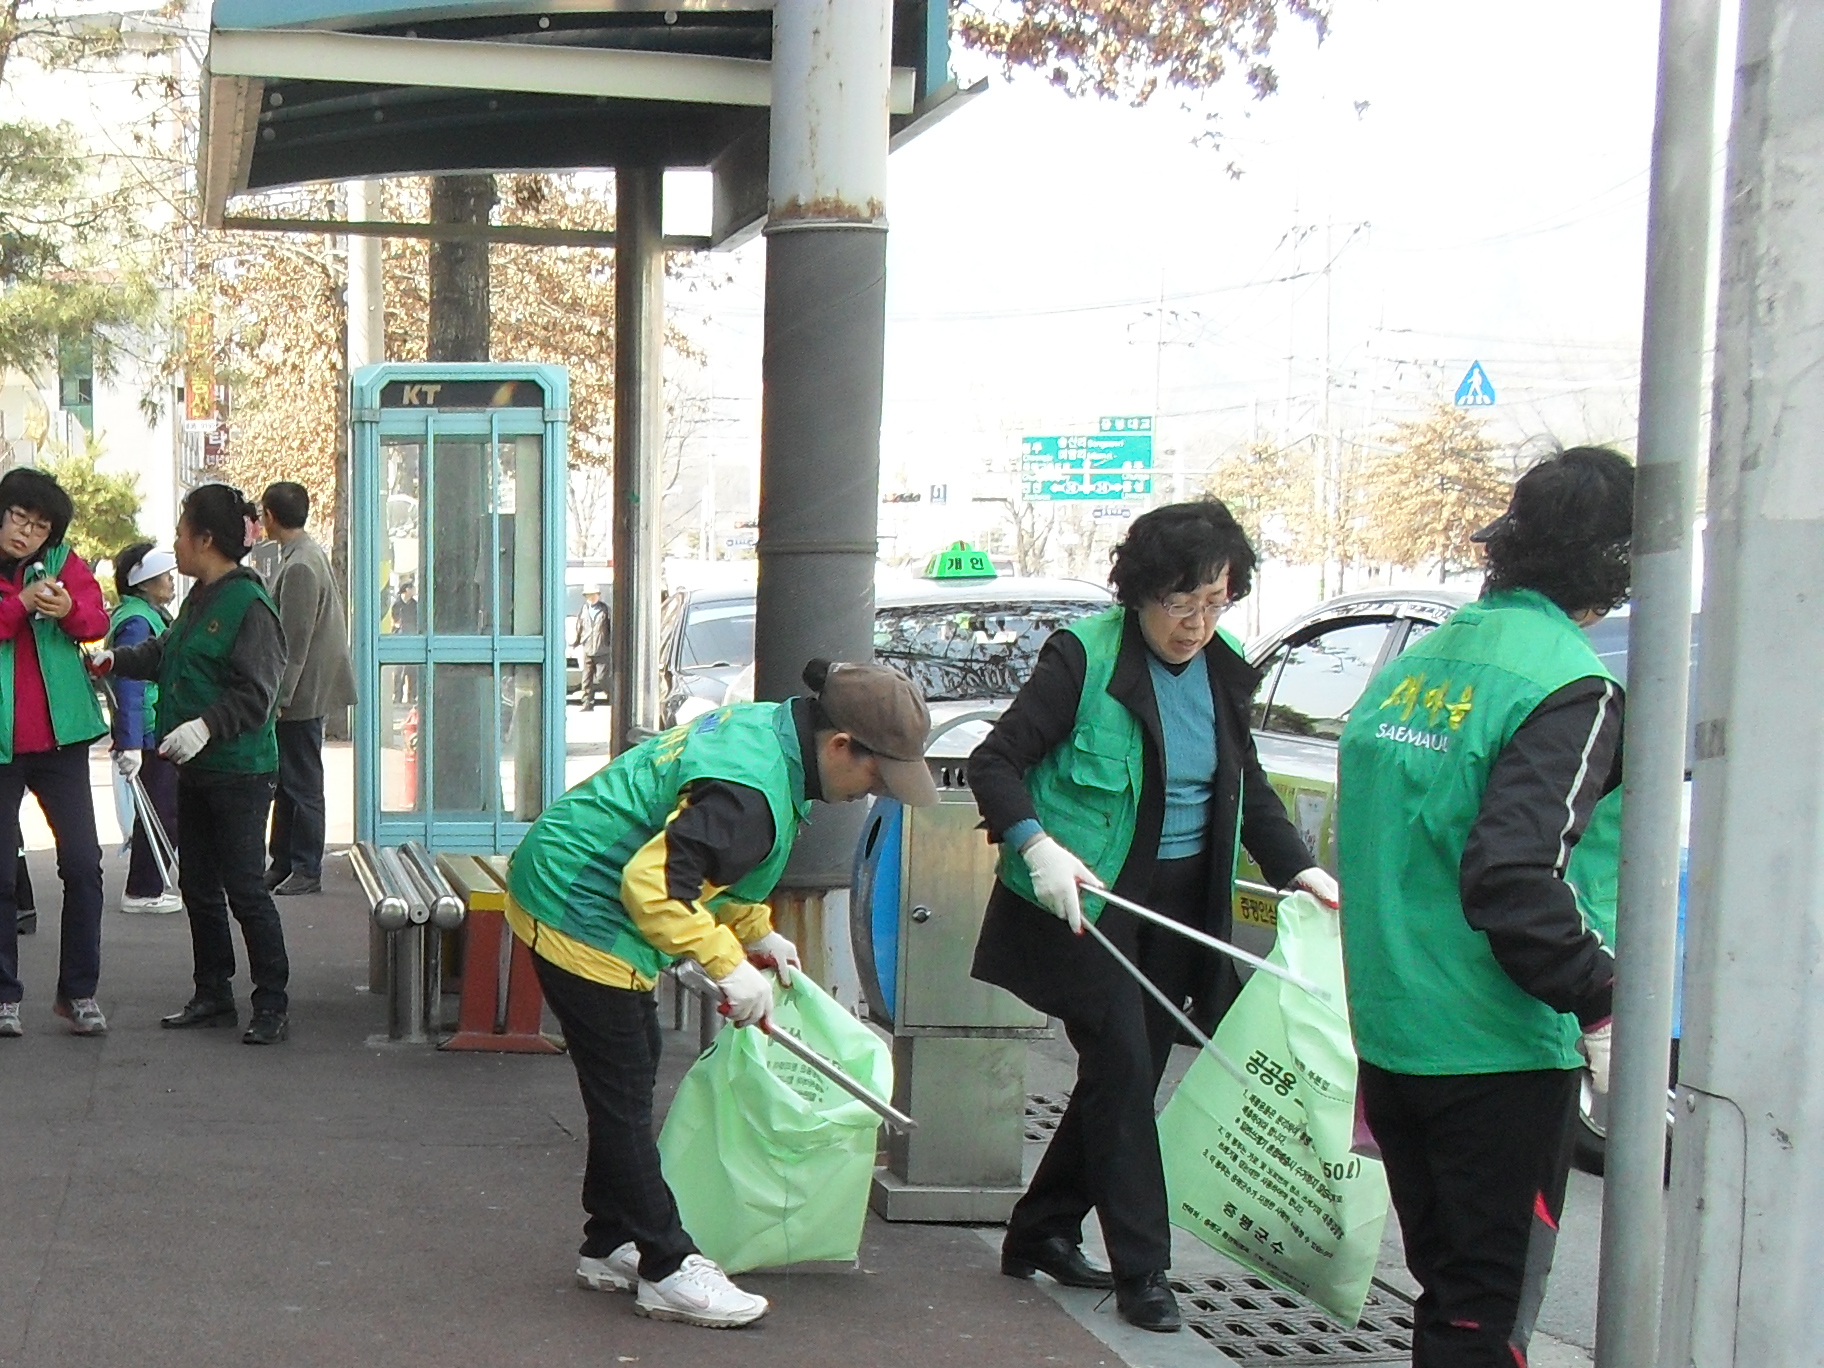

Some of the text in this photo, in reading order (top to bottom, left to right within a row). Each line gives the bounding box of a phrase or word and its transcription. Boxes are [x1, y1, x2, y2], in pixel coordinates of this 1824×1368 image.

[402, 384, 441, 405] KT
[1379, 672, 1473, 731] 새마을
[1375, 723, 1449, 752] SAEMAUL
[1246, 1050, 1298, 1096] 공공용
